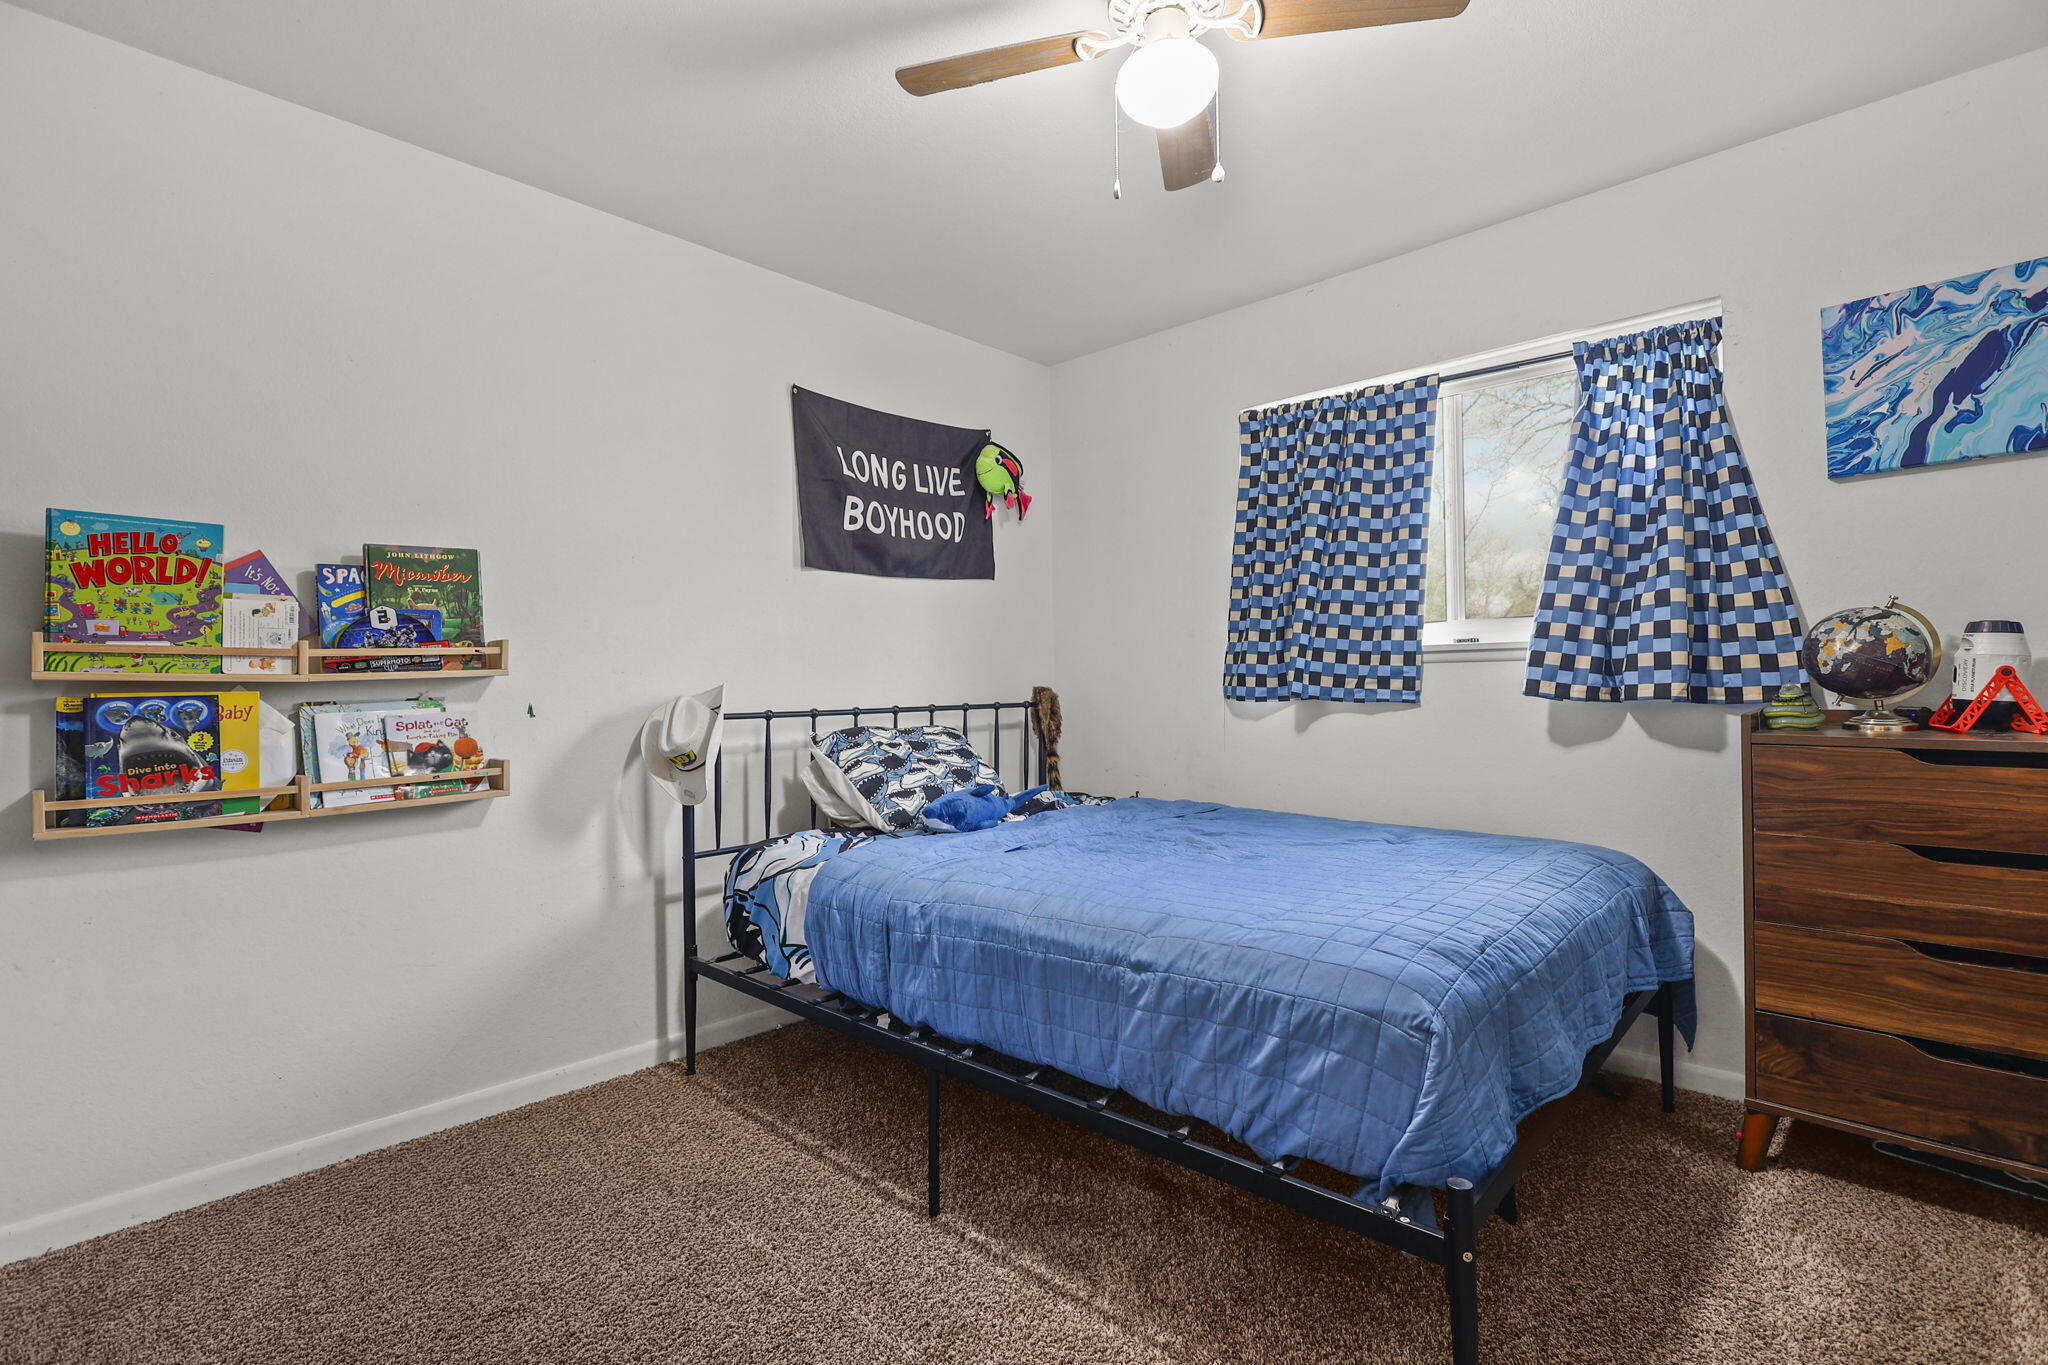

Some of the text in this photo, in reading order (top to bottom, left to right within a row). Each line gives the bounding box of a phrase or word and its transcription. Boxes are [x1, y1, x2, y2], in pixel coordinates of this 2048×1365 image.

[836, 446, 966, 496] LONG LIVE
[843, 495, 966, 543] BOYHOOD
[69, 556, 212, 589] WORLD!
[245, 565, 263, 582] It's
[370, 560, 472, 586] Micawber
[371, 657, 410, 668] SUPERMOTO
[1961, 657, 1969, 692] DISCOVERY
[365, 725, 384, 736] Kin
[395, 720, 433, 732] Splat
[444, 717, 469, 728] Cat
[197, 733, 205, 742] 3
[95, 764, 215, 796] Sharks
[128, 763, 177, 776] Dive into
